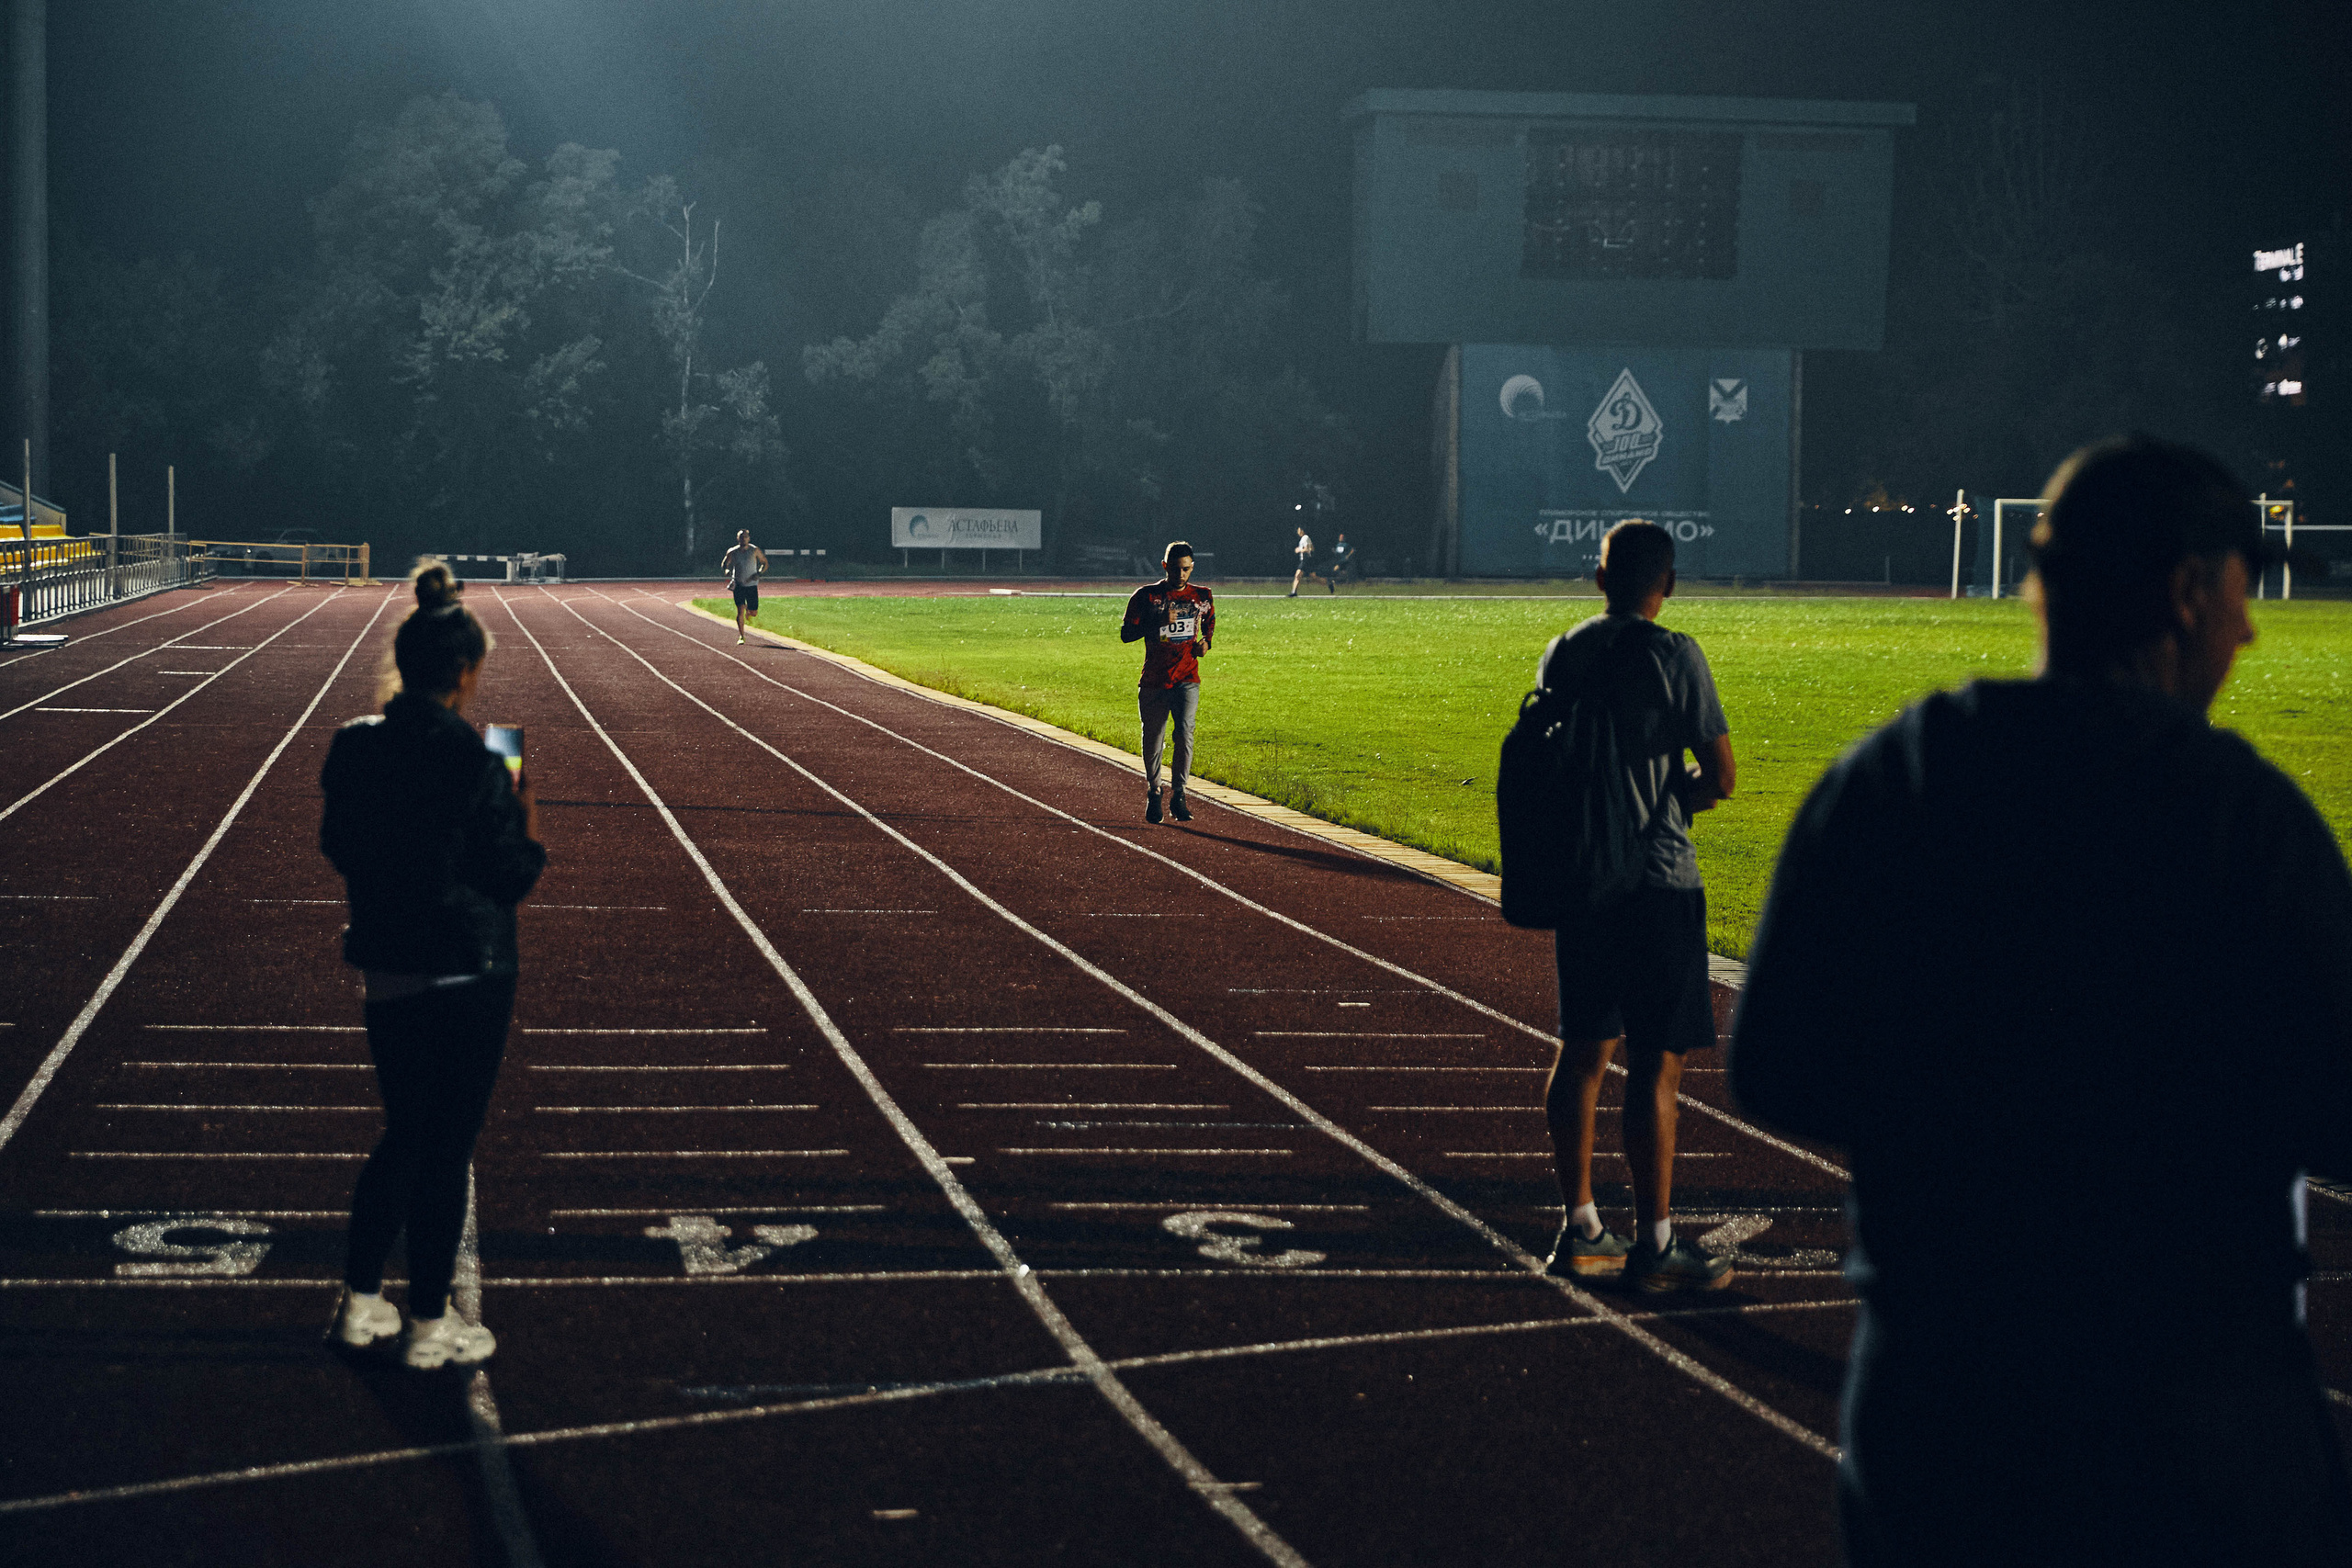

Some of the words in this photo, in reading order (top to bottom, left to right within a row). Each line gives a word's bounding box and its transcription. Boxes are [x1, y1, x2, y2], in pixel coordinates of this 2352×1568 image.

[948, 518, 1019, 533] АСТАФЬЕВА
[1169, 621, 1185, 633] 03
[110, 1218, 276, 1278] 5
[644, 1214, 820, 1276] 4
[1161, 1211, 1329, 1269] 3
